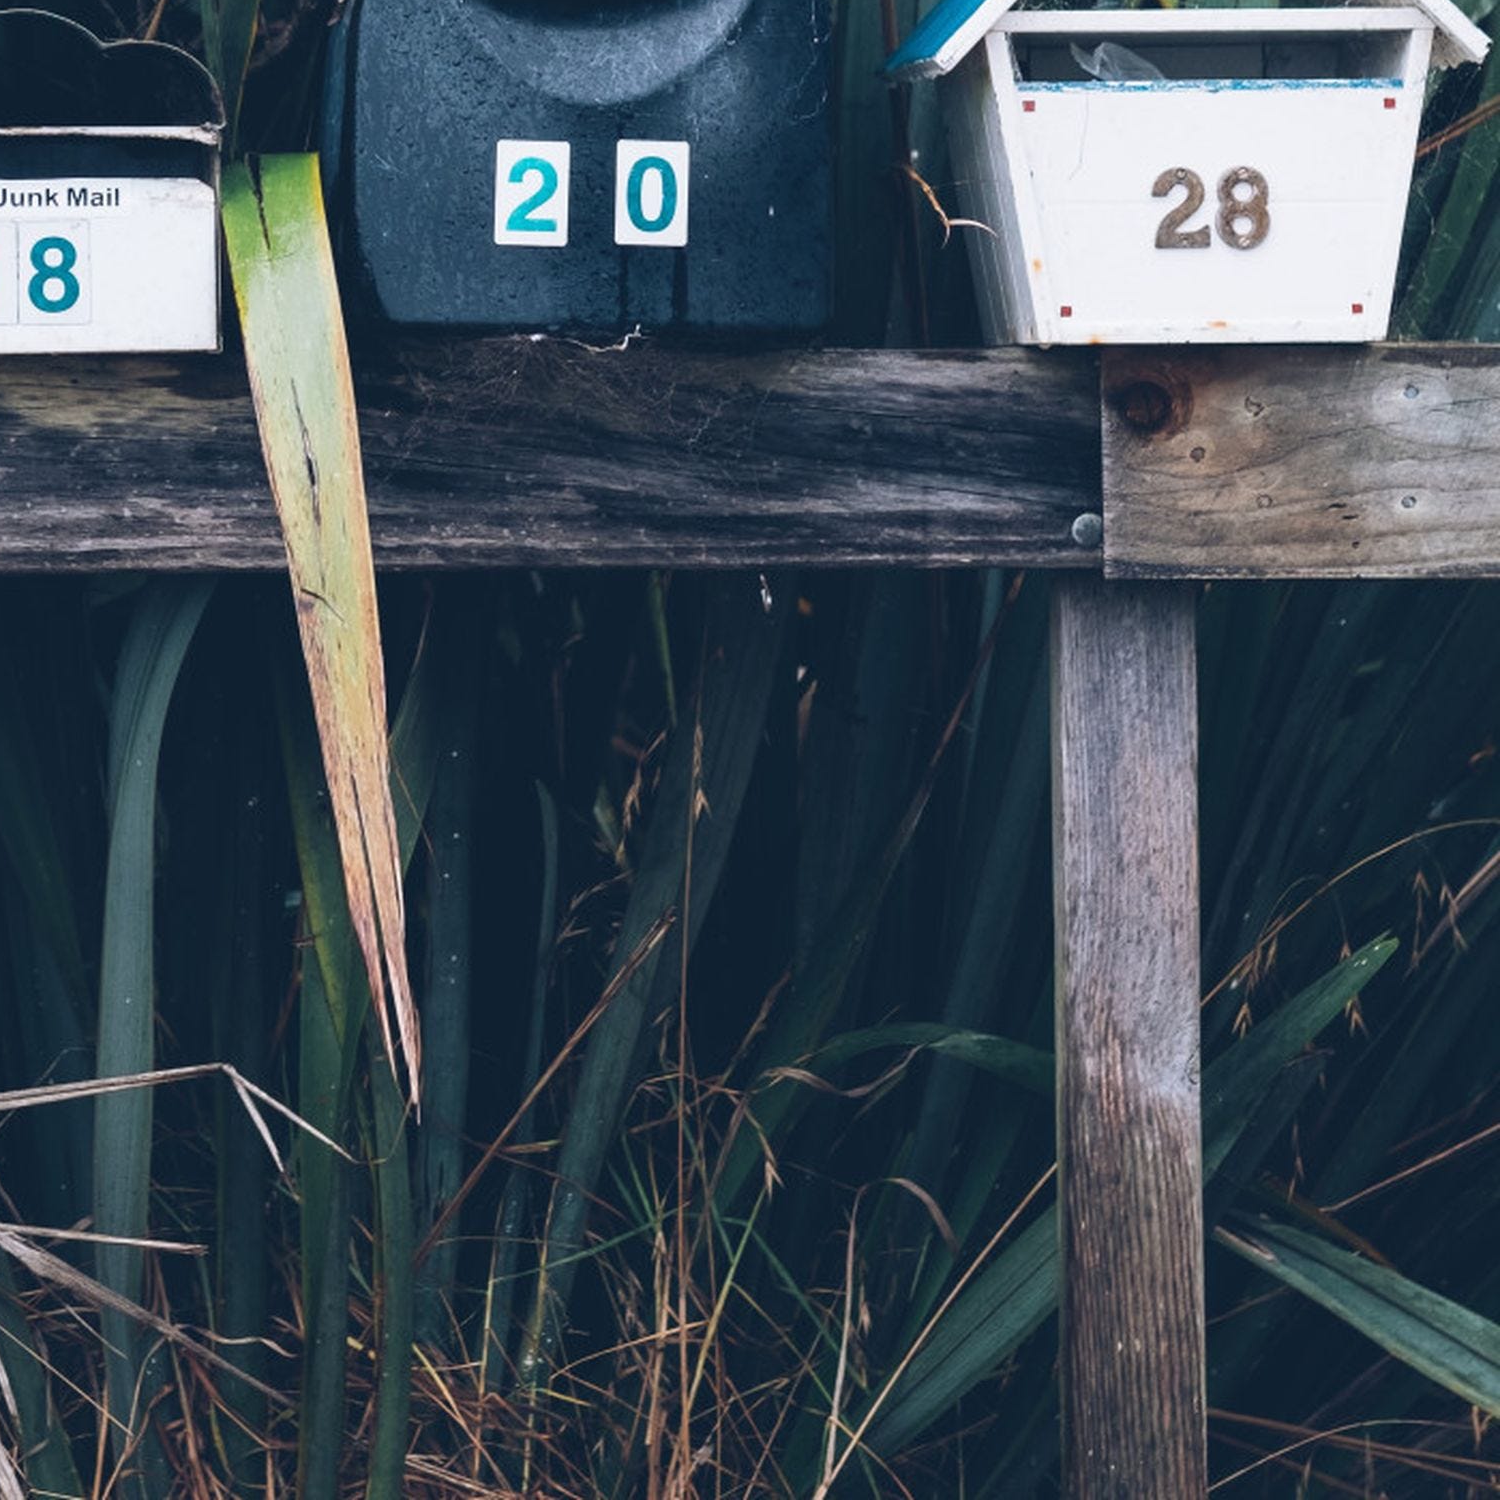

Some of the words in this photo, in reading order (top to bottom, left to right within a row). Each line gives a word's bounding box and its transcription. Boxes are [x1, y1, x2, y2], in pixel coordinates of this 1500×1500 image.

[67, 186, 121, 207] Mail
[504, 155, 678, 234] 20
[1150, 165, 1270, 251] 28
